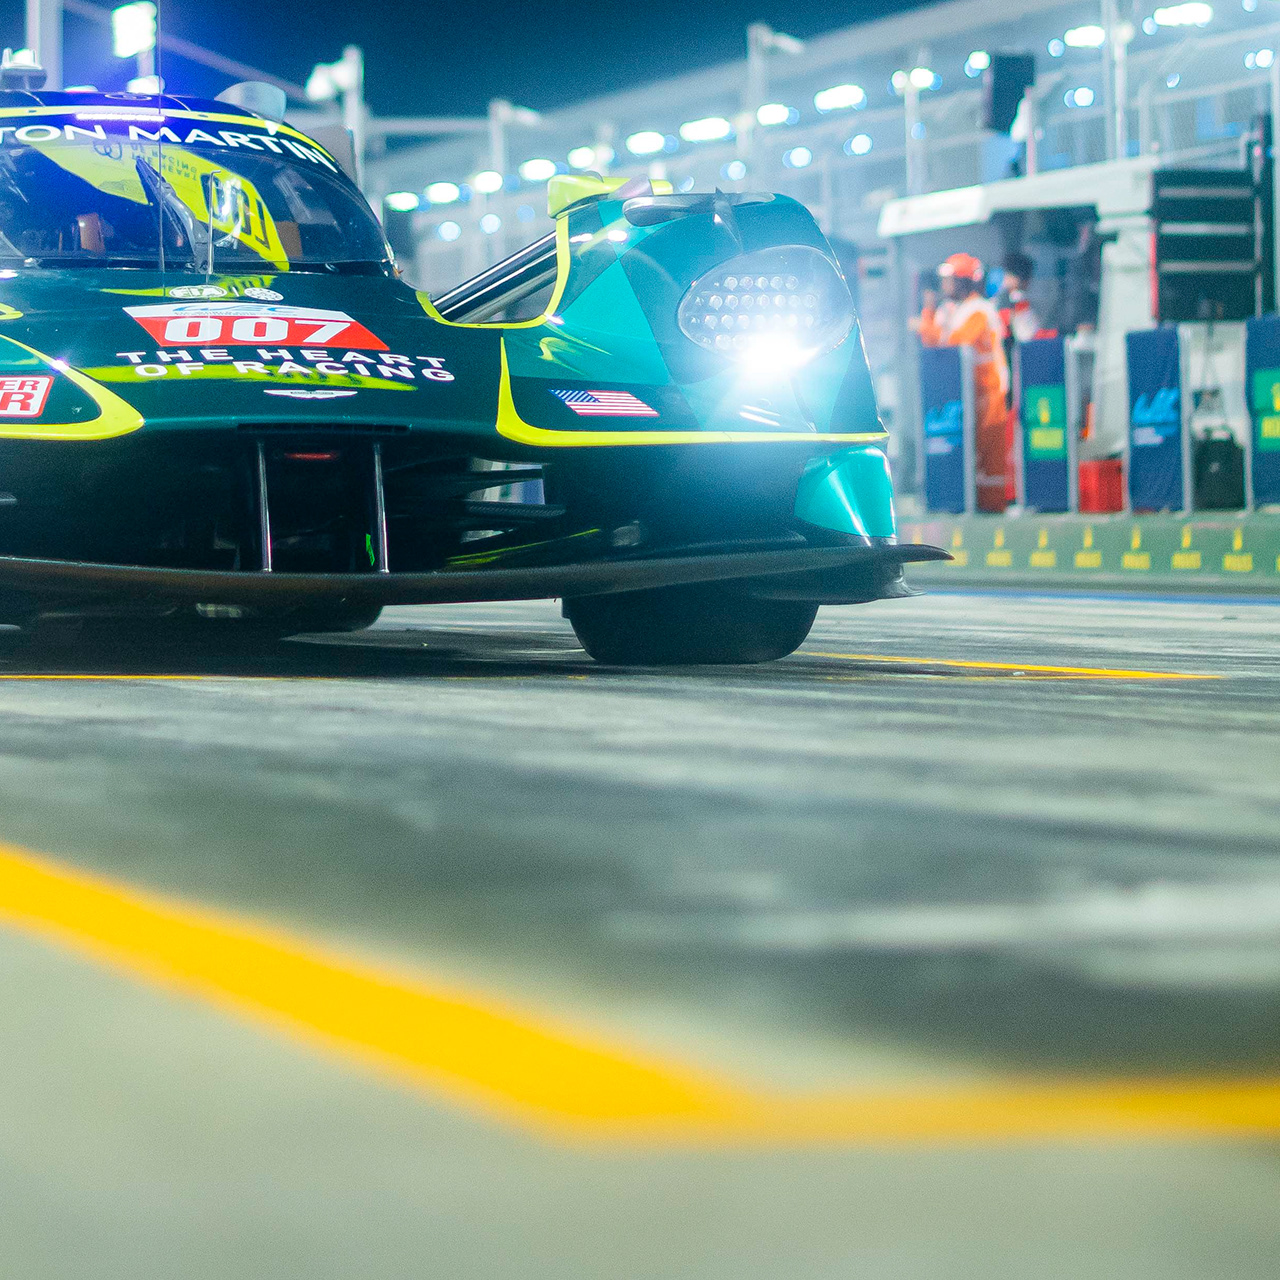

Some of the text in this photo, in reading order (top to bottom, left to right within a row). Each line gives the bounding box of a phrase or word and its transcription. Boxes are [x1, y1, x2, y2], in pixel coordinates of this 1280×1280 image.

[128, 125, 338, 173] MARTIN
[164, 317, 351, 343] 007
[116, 348, 446, 368] THE HEART
[134, 361, 456, 382] OF RACING
